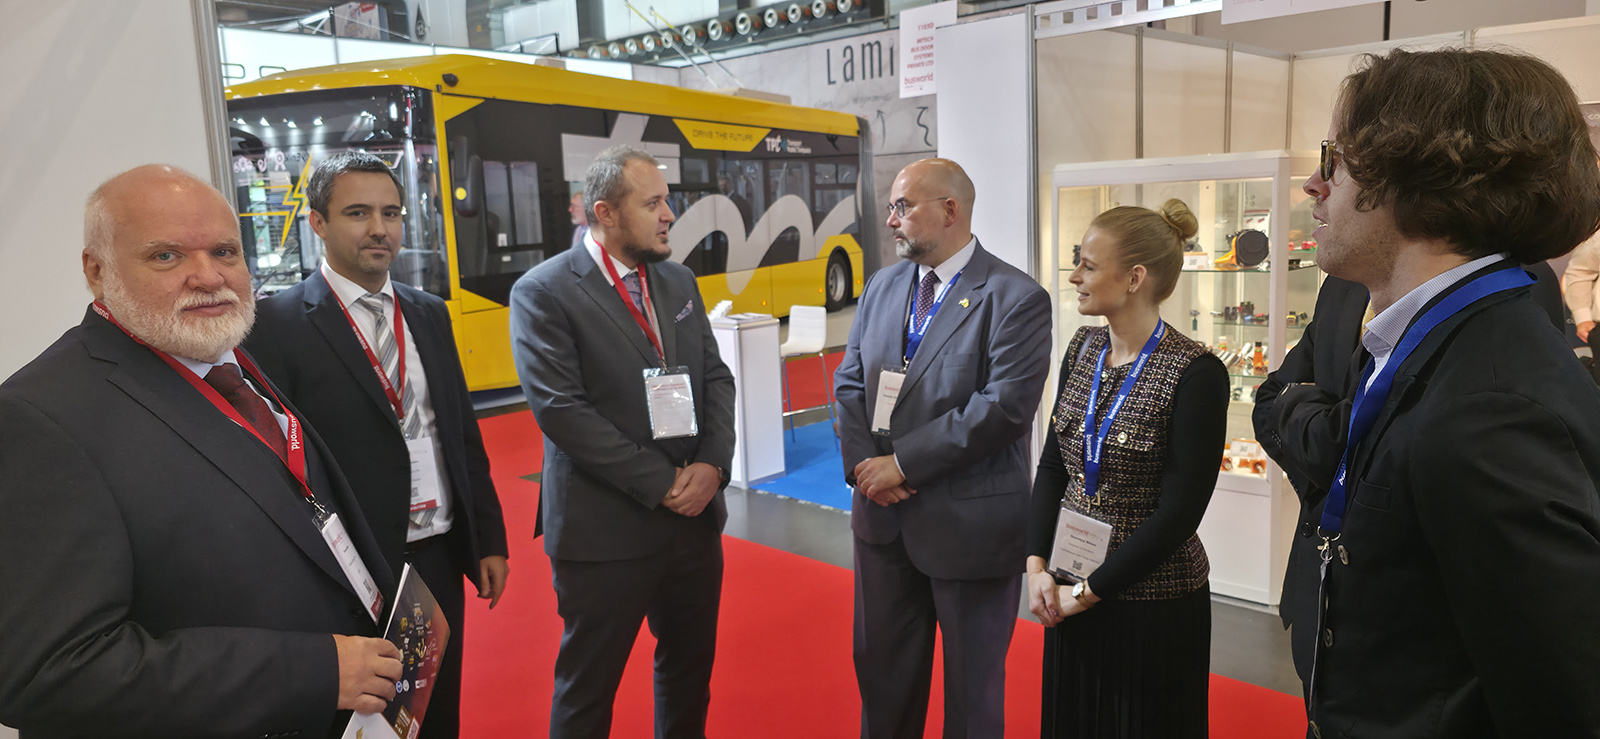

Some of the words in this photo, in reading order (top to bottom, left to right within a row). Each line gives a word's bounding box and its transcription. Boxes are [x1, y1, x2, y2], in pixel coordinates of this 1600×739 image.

[920, 44, 934, 52] DOOR
[906, 61, 925, 69] PRIVATE
[904, 73, 933, 85] busworld
[692, 129, 714, 139] DRIVE
[715, 131, 728, 140] THE
[730, 132, 753, 142] FUTURE
[1130, 352, 1149, 379] busworld
[1085, 434, 1093, 462] busworld
